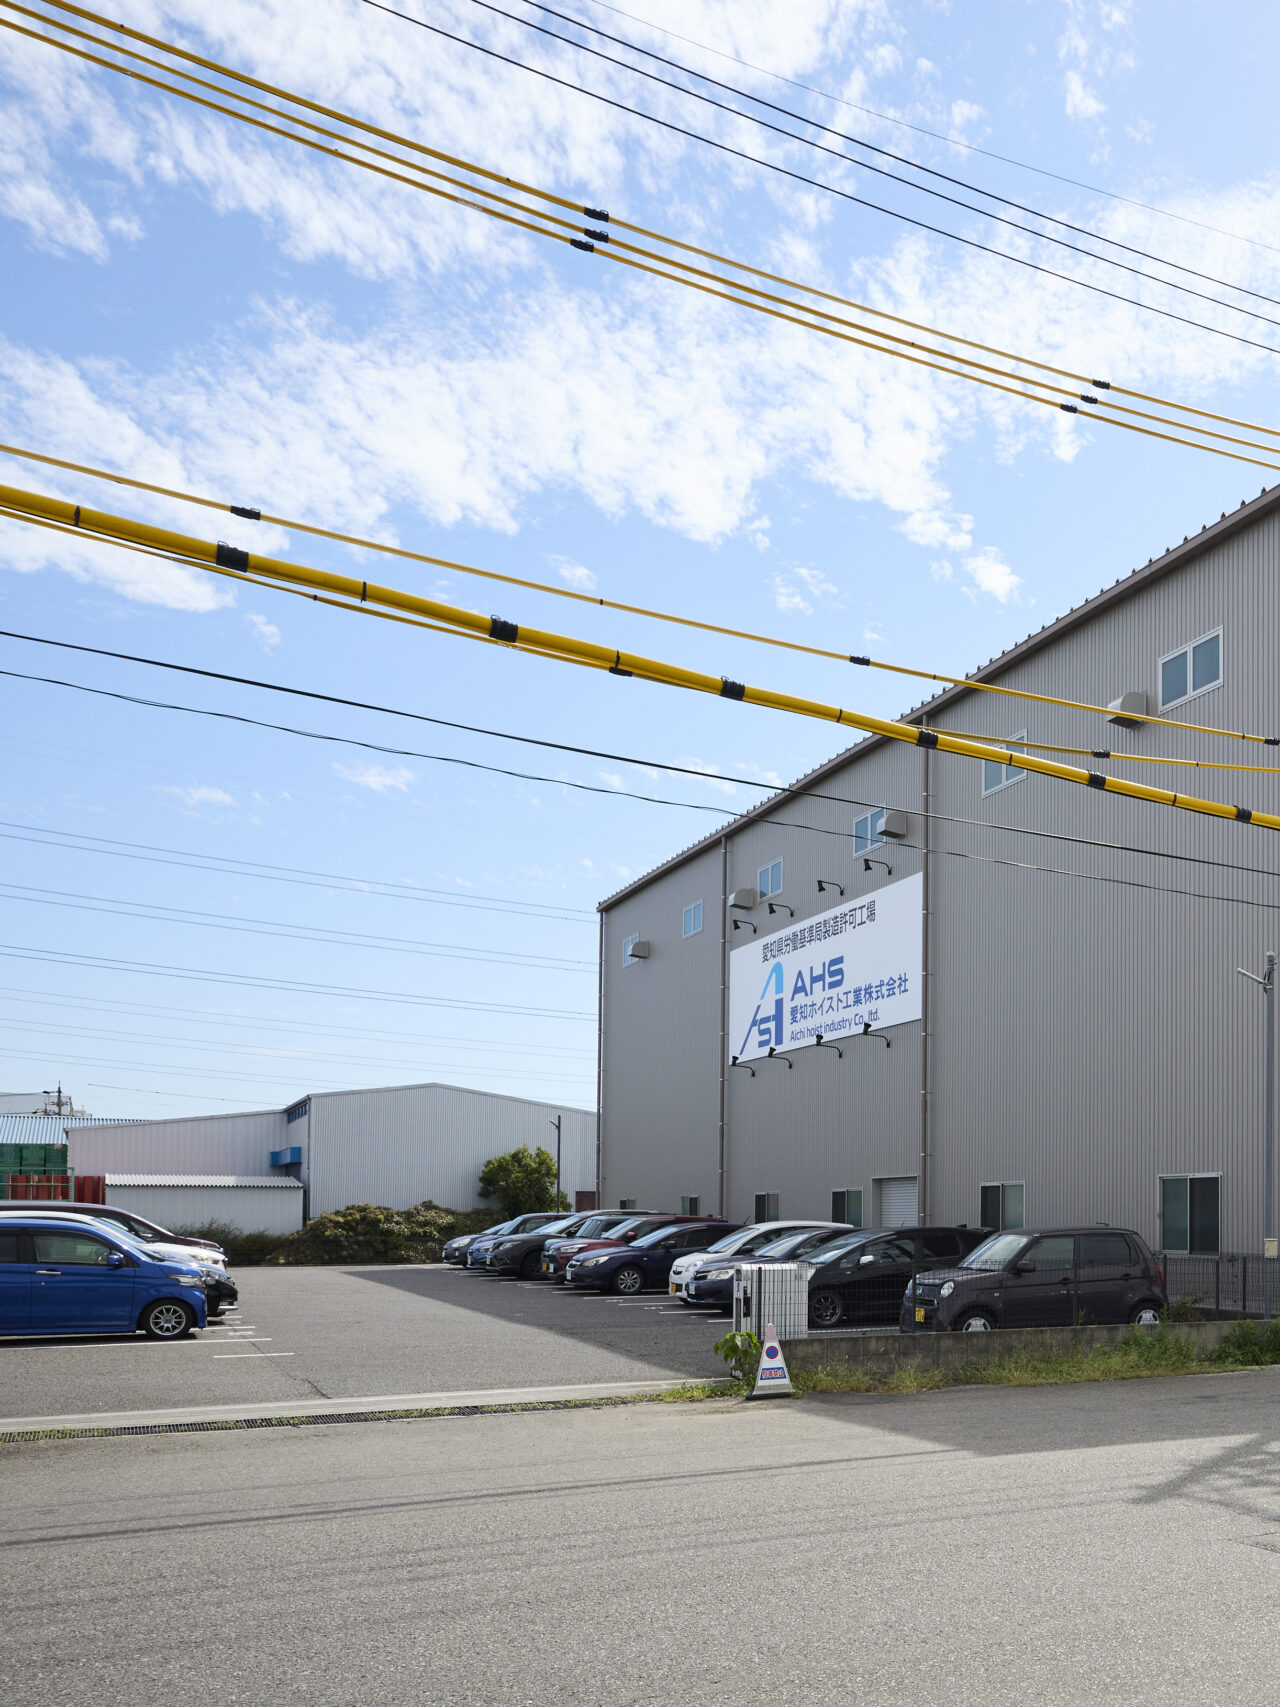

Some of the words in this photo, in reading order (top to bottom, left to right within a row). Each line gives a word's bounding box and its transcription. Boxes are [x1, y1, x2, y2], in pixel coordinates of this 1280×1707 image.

[761, 900, 876, 964] 愛知県労働基準局製造許可工場
[789, 972, 909, 1026] 愛知ホイスト工業株式会社
[790, 955, 845, 1002] AHS
[790, 1029, 806, 1042] Aichi
[806, 1022, 823, 1037] hoist
[823, 1016, 853, 1034] industry
